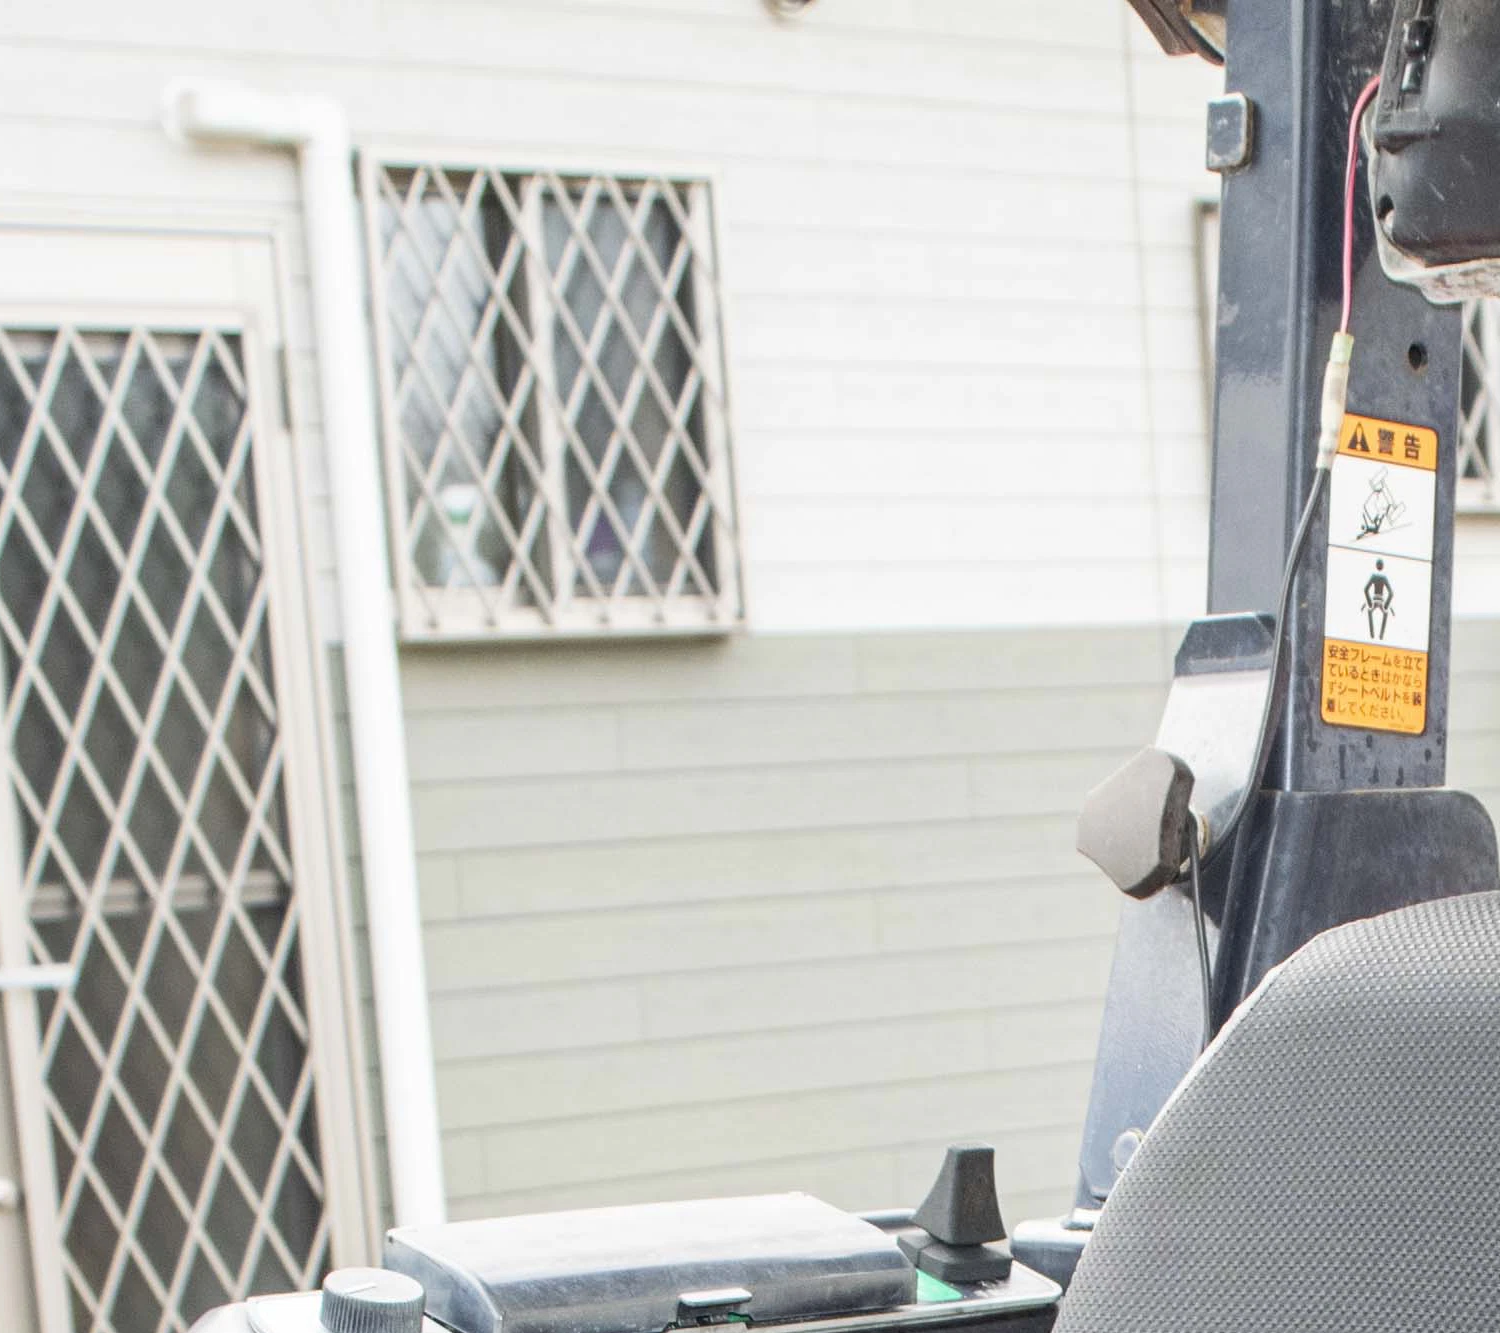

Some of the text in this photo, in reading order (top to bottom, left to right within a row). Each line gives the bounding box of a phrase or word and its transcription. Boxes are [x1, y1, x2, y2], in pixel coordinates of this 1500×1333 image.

[1377, 427, 1422, 460] 警告
[1328, 644, 1423, 671] 安全フレームを立て
[1327, 662, 1422, 689] ているときはかなら
